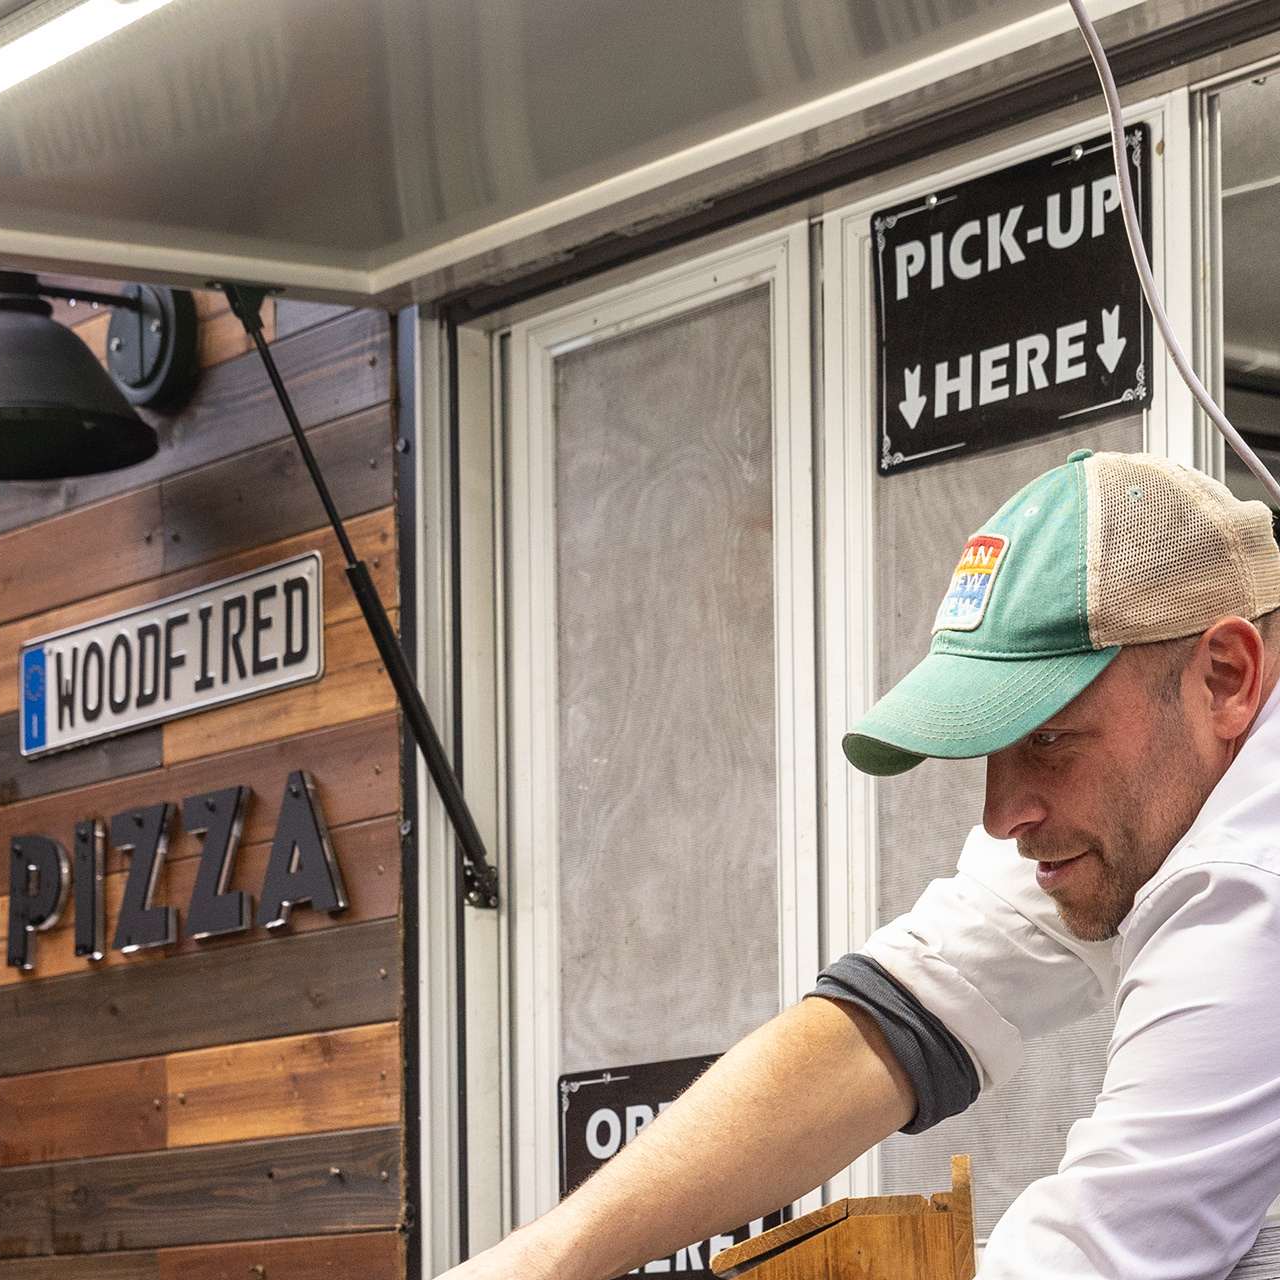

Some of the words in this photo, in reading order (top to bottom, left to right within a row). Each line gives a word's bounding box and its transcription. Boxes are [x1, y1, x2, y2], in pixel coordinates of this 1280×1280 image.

[894, 173, 1122, 301] PICK-UP
[934, 319, 1088, 419] HERE
[55, 575, 311, 731] WOODFIRED
[7, 770, 349, 970] PIZZA
